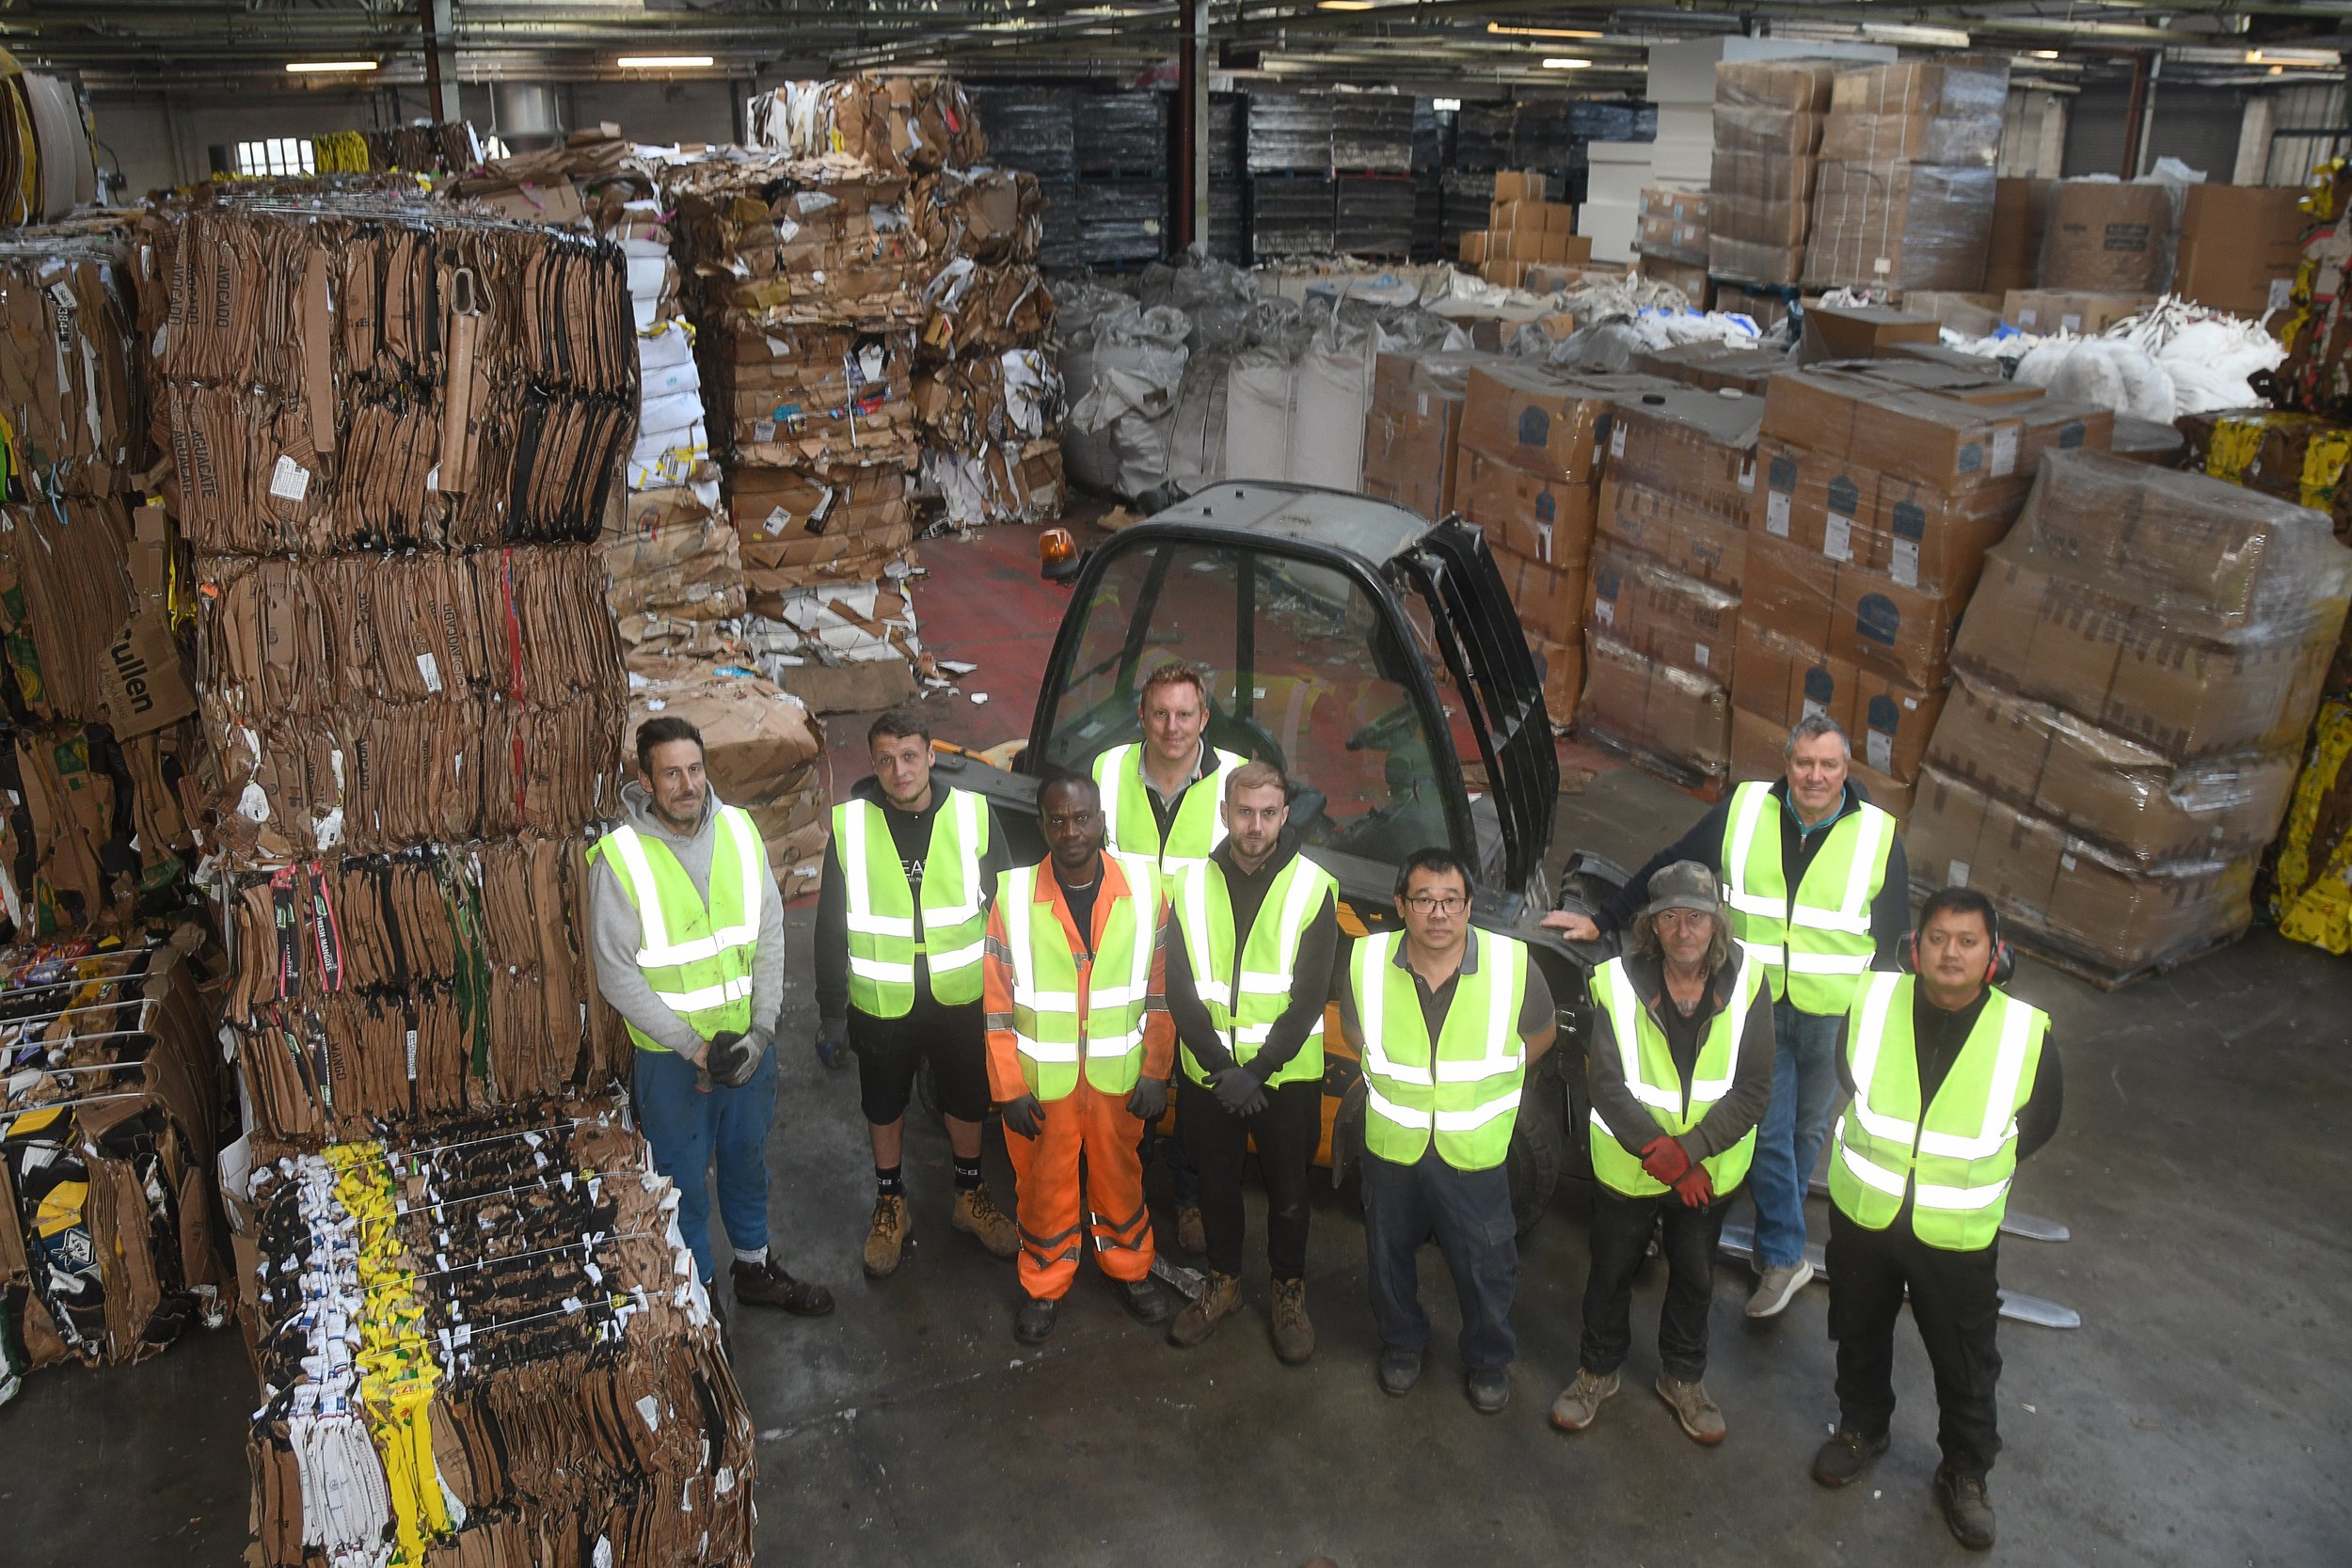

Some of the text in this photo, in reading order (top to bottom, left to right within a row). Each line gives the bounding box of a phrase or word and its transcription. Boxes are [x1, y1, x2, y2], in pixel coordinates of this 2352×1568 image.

[215, 264, 230, 328] AVOCADO
[191, 428, 217, 499] AGUACATE
[443, 603, 462, 658] AVOCADO
[103, 668, 128, 722] PACKAGING
[111, 628, 153, 714] ullen
[316, 916, 333, 974] FRESH MANGOES
[329, 1041, 347, 1082] MANGO
[71, 1238, 87, 1258] FAST
